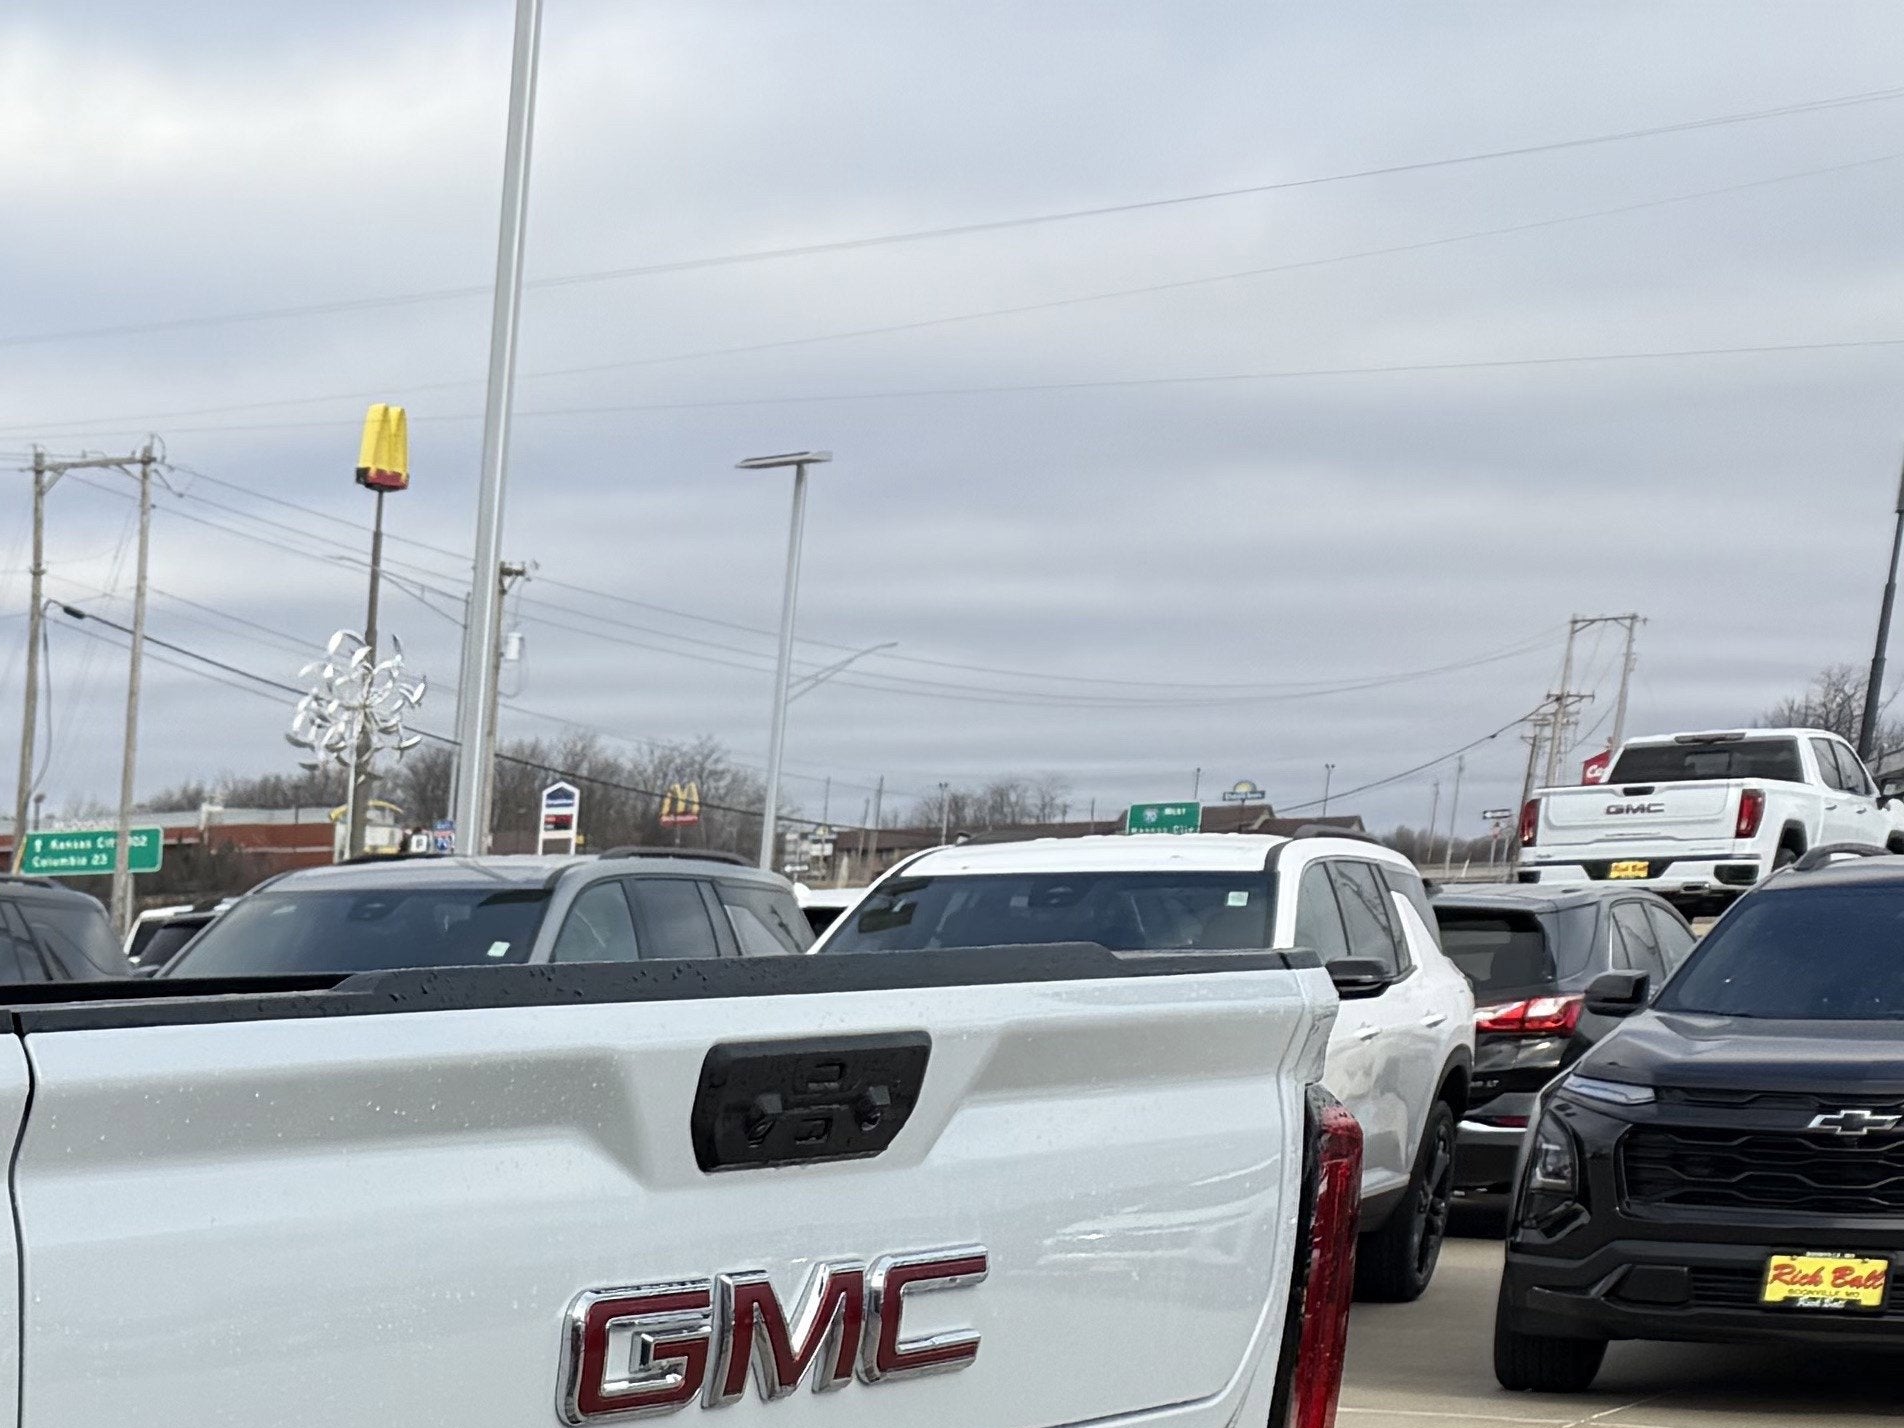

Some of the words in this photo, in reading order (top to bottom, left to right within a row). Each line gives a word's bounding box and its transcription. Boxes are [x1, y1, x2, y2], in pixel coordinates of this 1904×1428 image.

[1605, 803, 1665, 816] GMC
[1769, 1263, 1825, 1287] Rick
[1831, 1265, 1886, 1289] Ball
[555, 1242, 989, 1427] GMC
